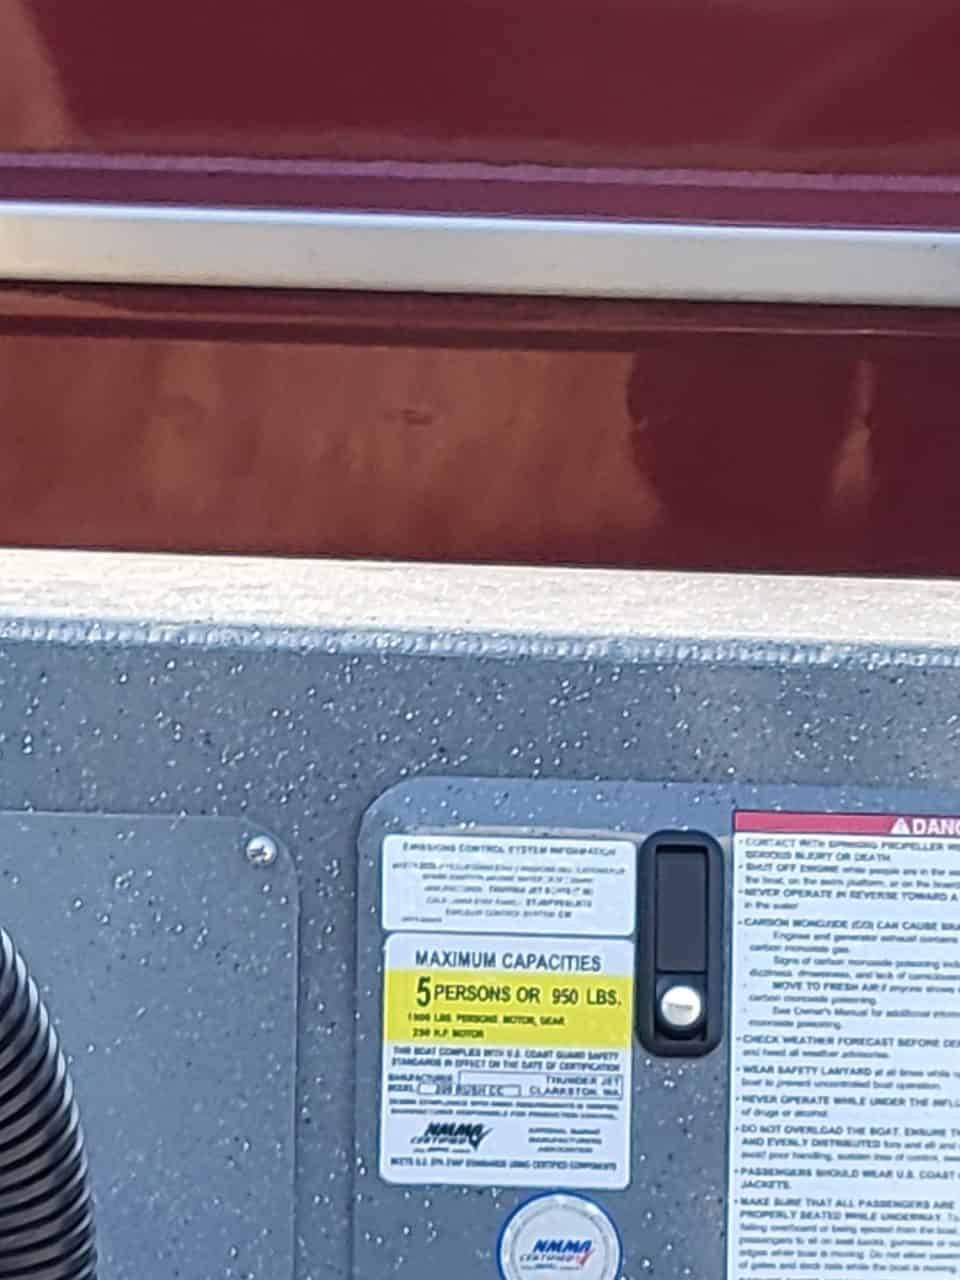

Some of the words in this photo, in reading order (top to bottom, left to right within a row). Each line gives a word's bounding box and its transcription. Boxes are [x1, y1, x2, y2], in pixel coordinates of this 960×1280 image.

[414, 948, 496, 969] MAXIMUM
[501, 951, 601, 973] CAPACITIES
[415, 975, 432, 1008] 5
[433, 983, 511, 1003] PERSONS
[515, 985, 541, 1004] OR
[551, 987, 579, 1005] 950
[585, 988, 621, 1006] LBS.
